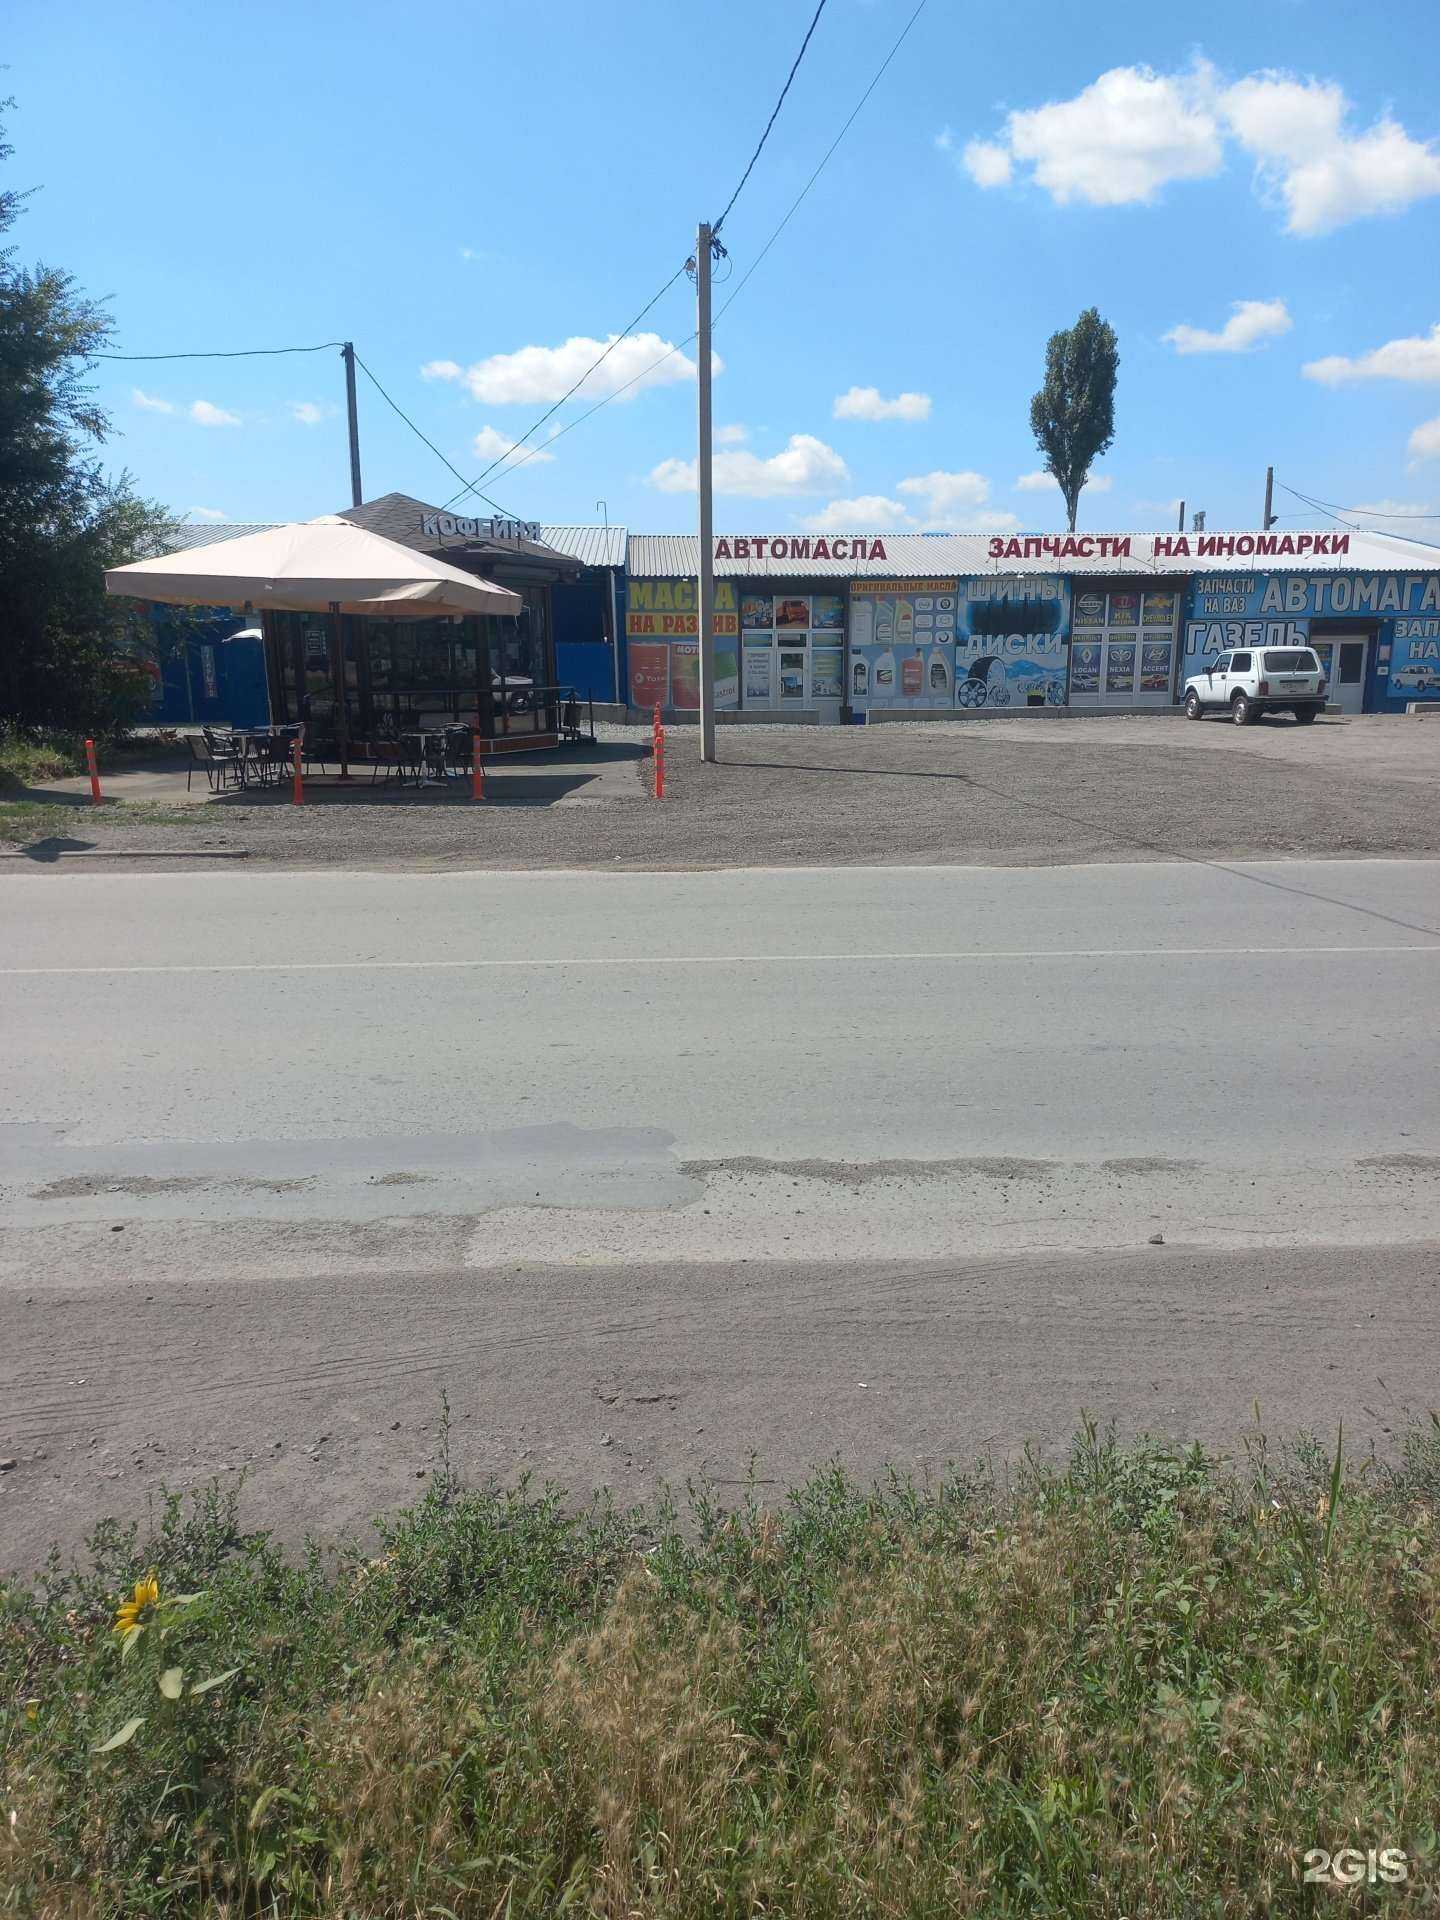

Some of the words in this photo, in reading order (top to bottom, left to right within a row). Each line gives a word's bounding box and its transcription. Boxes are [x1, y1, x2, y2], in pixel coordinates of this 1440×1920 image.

[421, 513, 540, 540] КОФЕЙНЯ
[715, 538, 887, 560] АВТОМАСЛА
[988, 537, 1131, 558] ЗАПЧАСТИ
[1154, 536, 1190, 557] НА
[1198, 534, 1349, 556] ИНОМАРКИ
[629, 582, 735, 609] МАСА
[967, 579, 1065, 602] ШИНЫ
[1197, 578, 1255, 594] ЗАПЧАСТИ
[1204, 597, 1219, 613] НА
[1223, 597, 1246, 613] ВАЗ
[629, 615, 655, 632] НА
[662, 615, 737, 632] РАЗИВ
[967, 632, 1062, 656] ДИСКИ
[1185, 622, 1307, 655] ГАЗЕЛЬ
[1408, 641, 1440, 660] НА
